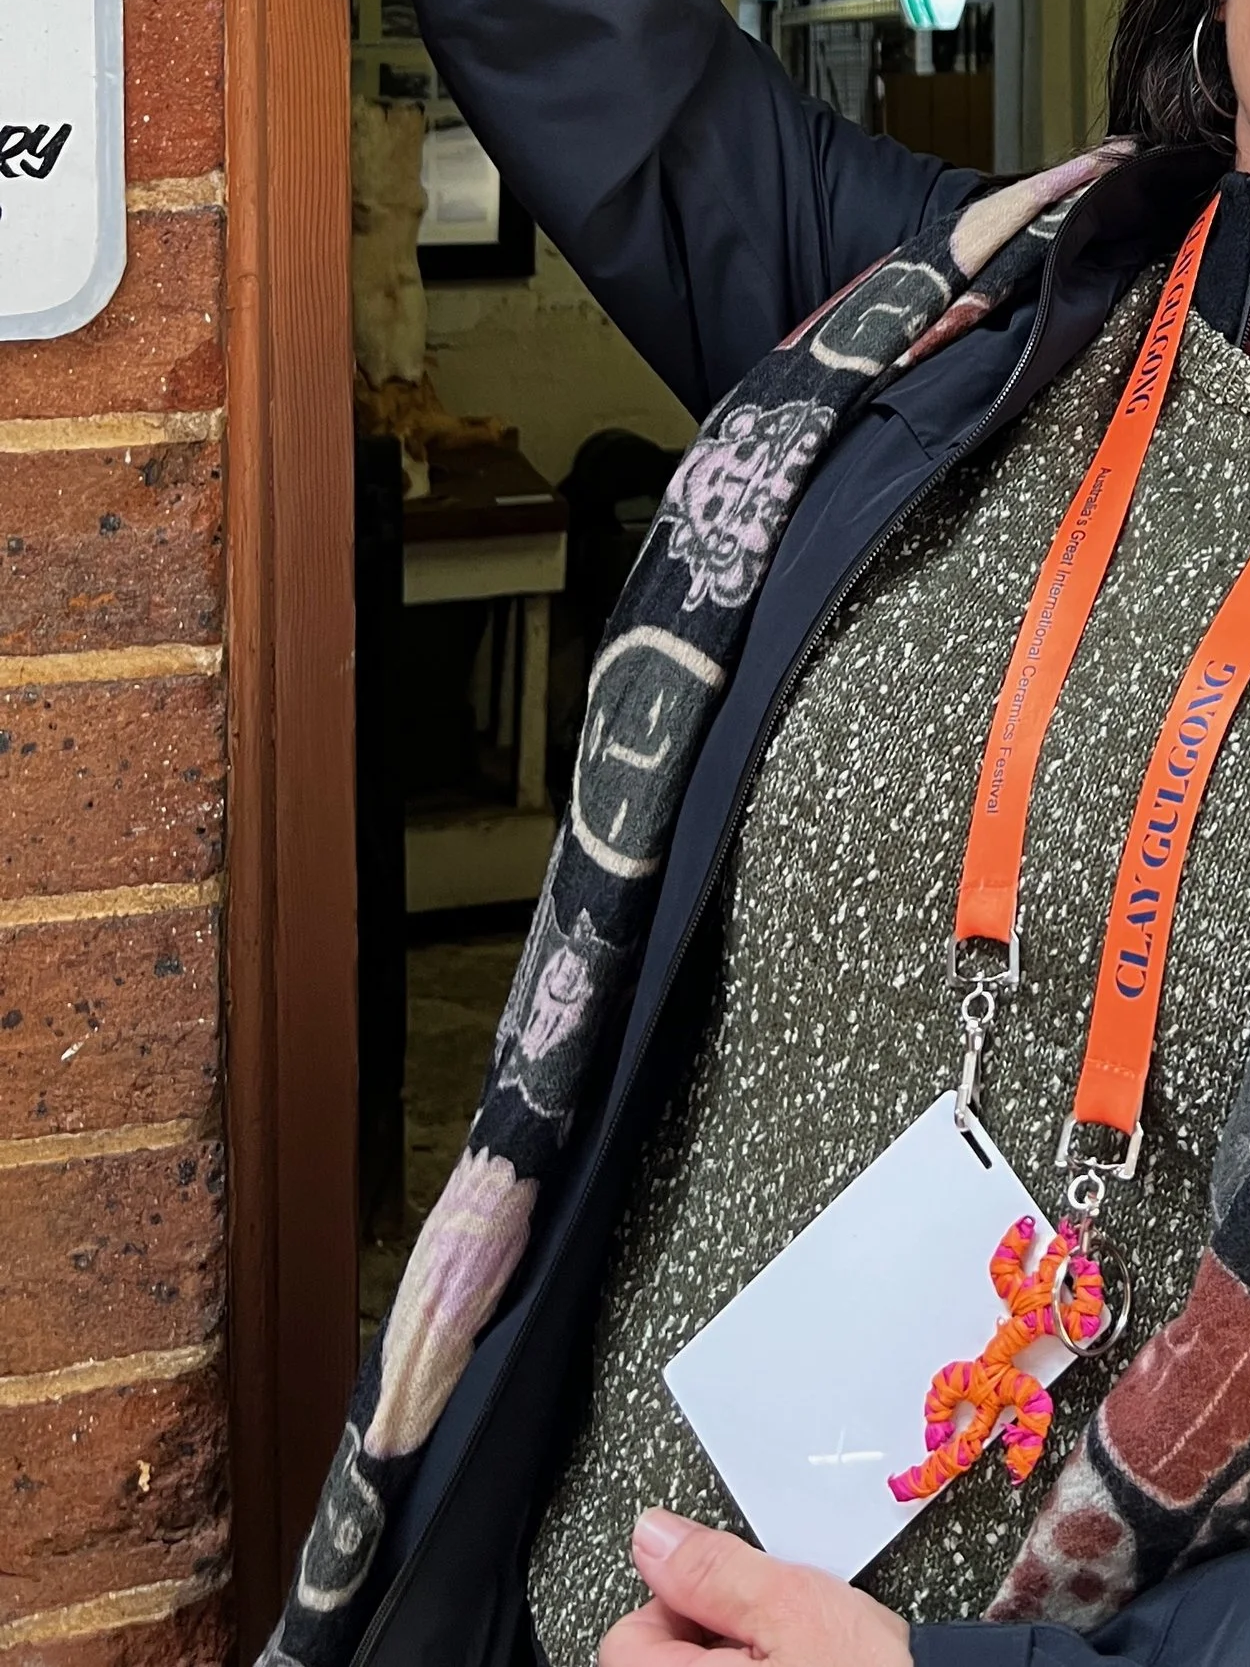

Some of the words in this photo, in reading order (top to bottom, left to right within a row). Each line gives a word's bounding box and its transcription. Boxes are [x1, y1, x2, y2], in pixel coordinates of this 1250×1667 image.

[1125, 282, 1184, 415] GULGONG
[1075, 467, 1112, 525] Australia's
[1059, 529, 1086, 567] Great
[1027, 570, 1073, 661] International
[1001, 665, 1037, 741] Ceramics
[986, 746, 1013, 815] Festival
[1115, 875, 1161, 999] CLAY
[1141, 660, 1236, 868] GULGONG
